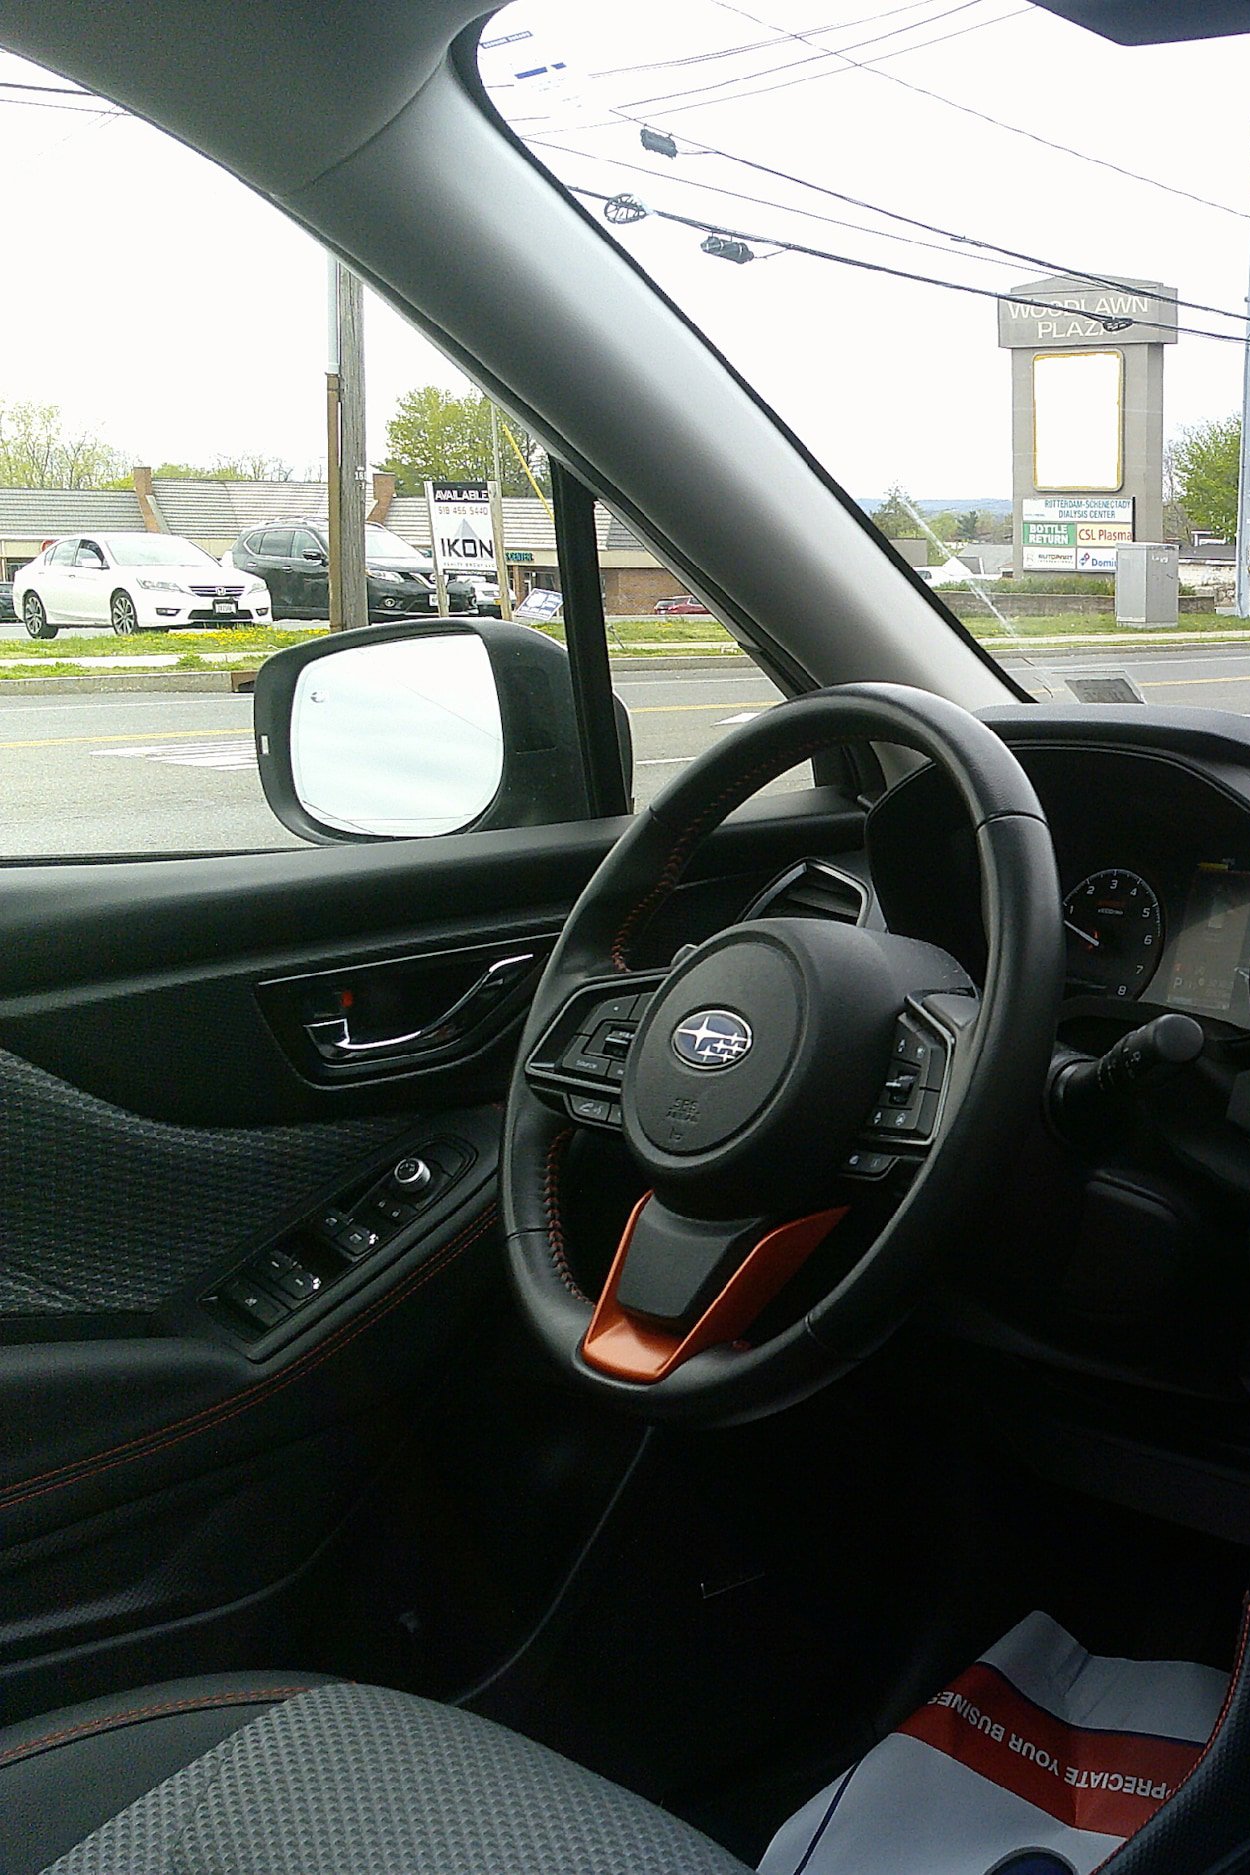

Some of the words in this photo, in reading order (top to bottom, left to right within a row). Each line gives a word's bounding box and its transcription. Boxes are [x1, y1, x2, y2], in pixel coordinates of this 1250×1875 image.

[1008, 297, 1148, 319] WOODLAWN
[435, 489, 489, 501] AVAILABLE
[1058, 510, 1088, 519] DIALYSIS
[1089, 510, 1116, 519] CENTER
[1029, 524, 1068, 534] BOTTLE
[1078, 528, 1097, 541] CSL
[1098, 529, 1132, 541] Plasma
[1028, 534, 1069, 544] RETURN
[441, 538, 494, 559] IKON
[1086, 885, 1095, 895] 2
[1109, 879, 1119, 890] 3
[1130, 887, 1137, 897] 4
[1069, 905, 1075, 915] 1
[1142, 907, 1151, 918] 5
[1144, 934, 1153, 946] 6
[1135, 964, 1144, 975] 7
[1117, 985, 1127, 996] 8
[1008, 1733, 1059, 1777] YOUR
[1064, 1766, 1172, 1800] PRECIATE
